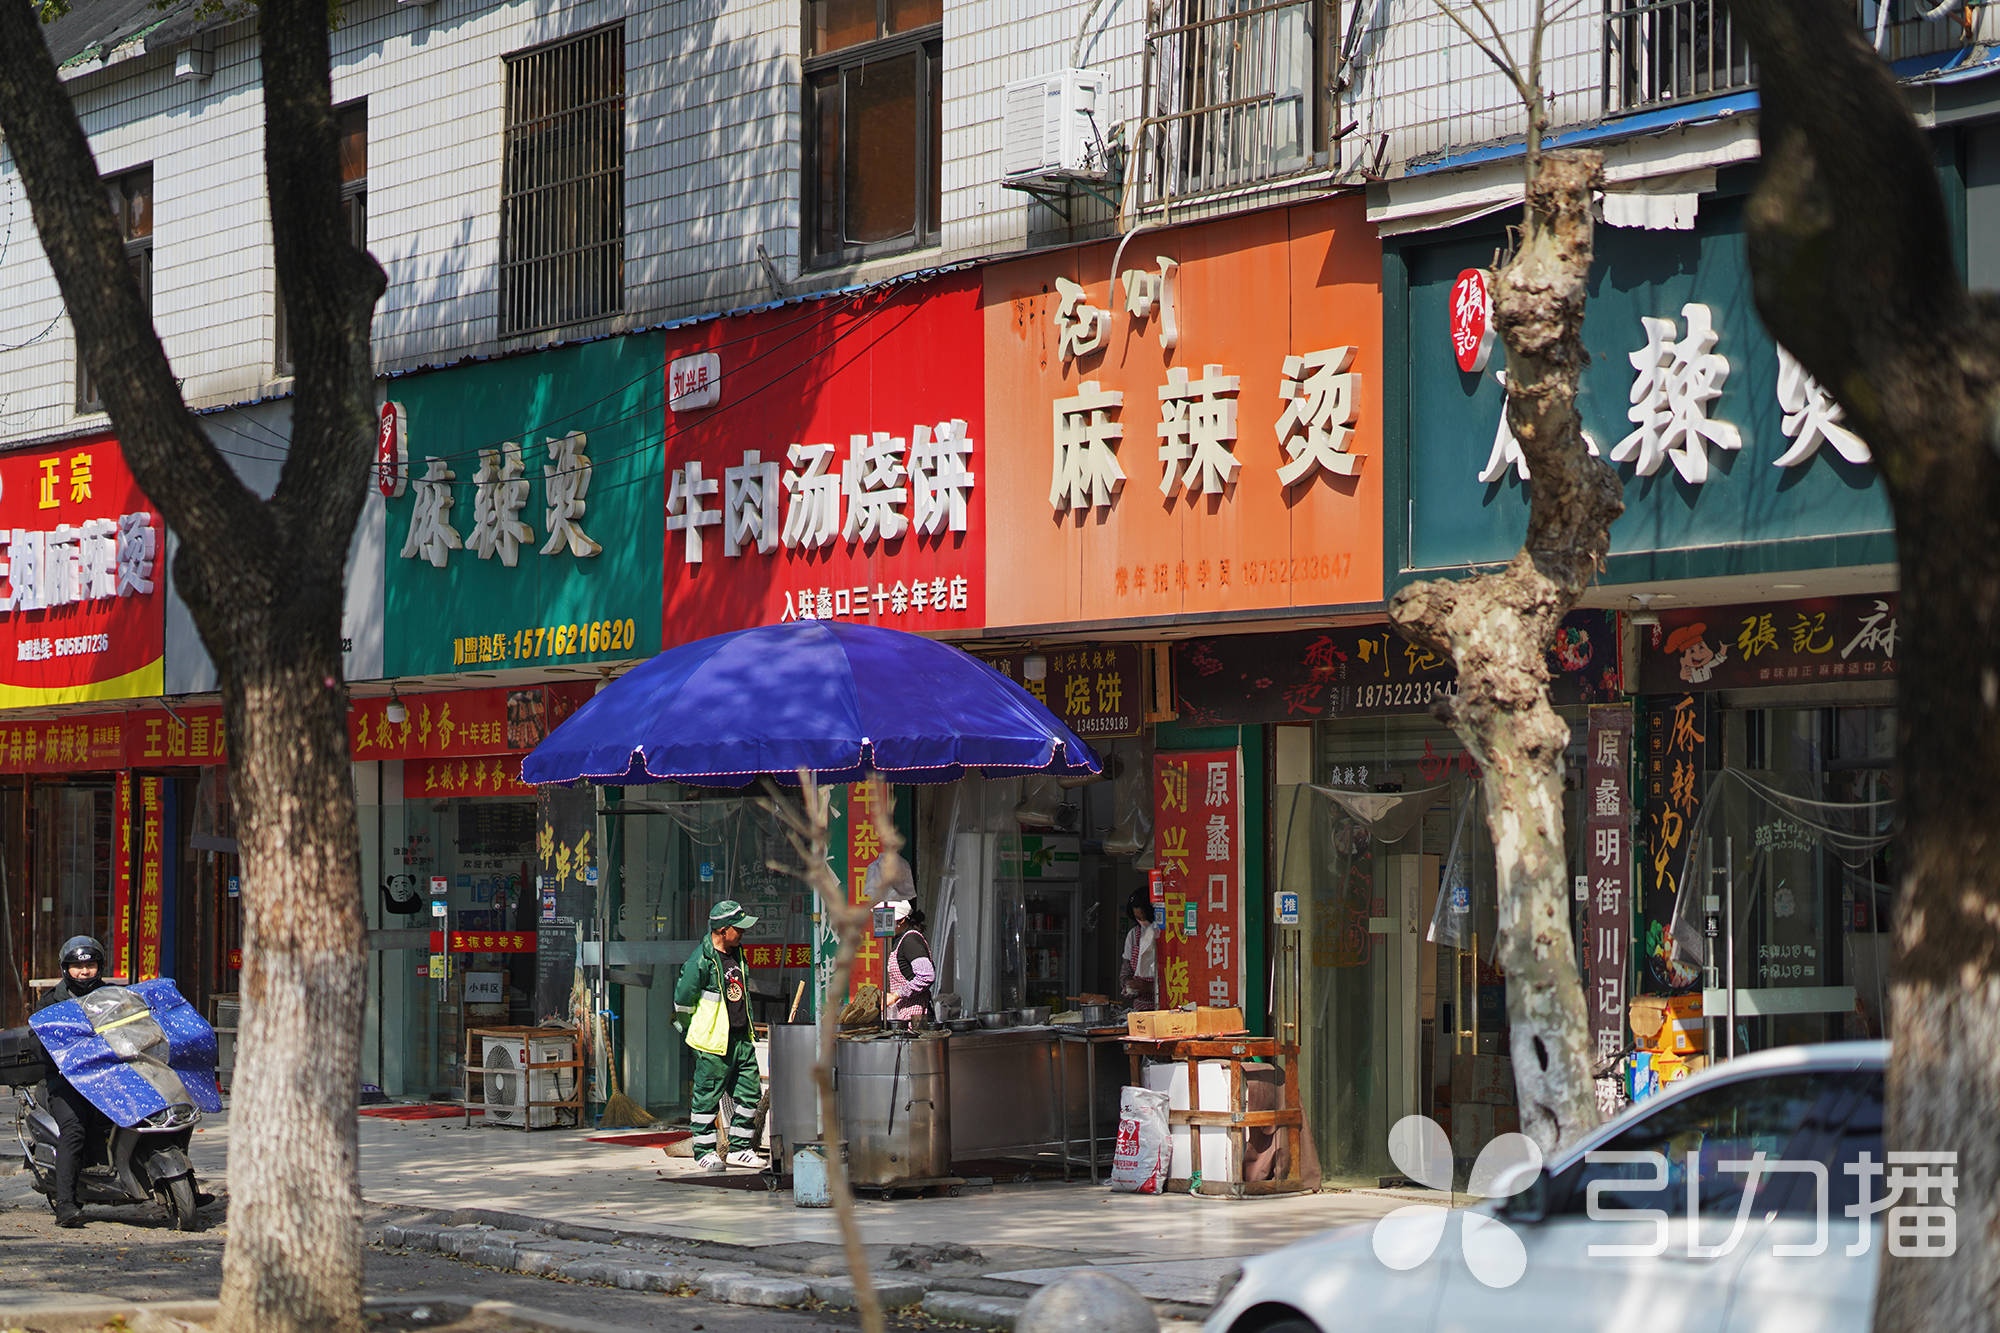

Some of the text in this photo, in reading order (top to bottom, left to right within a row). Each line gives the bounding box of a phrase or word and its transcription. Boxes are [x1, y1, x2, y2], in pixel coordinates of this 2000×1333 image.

[673, 367, 708, 398] 刘兴民
[1049, 346, 1367, 511] 麻辣烫
[39, 453, 92, 510] 正宗
[400, 430, 602, 568] 麻辣烫
[666, 419, 974, 564] 牛肉汤烧饼
[781, 574, 967, 623] 入驻蠡口三十余年老店
[1065, 671, 1123, 717] 烧饼
[459, 720, 502, 745] 十年老店
[143, 776, 159, 980] 重庆麻辣烫
[1284, 897, 1297, 913] 推
[743, 946, 811, 965] 麻辣烫
[469, 982, 504, 994] 小料区
